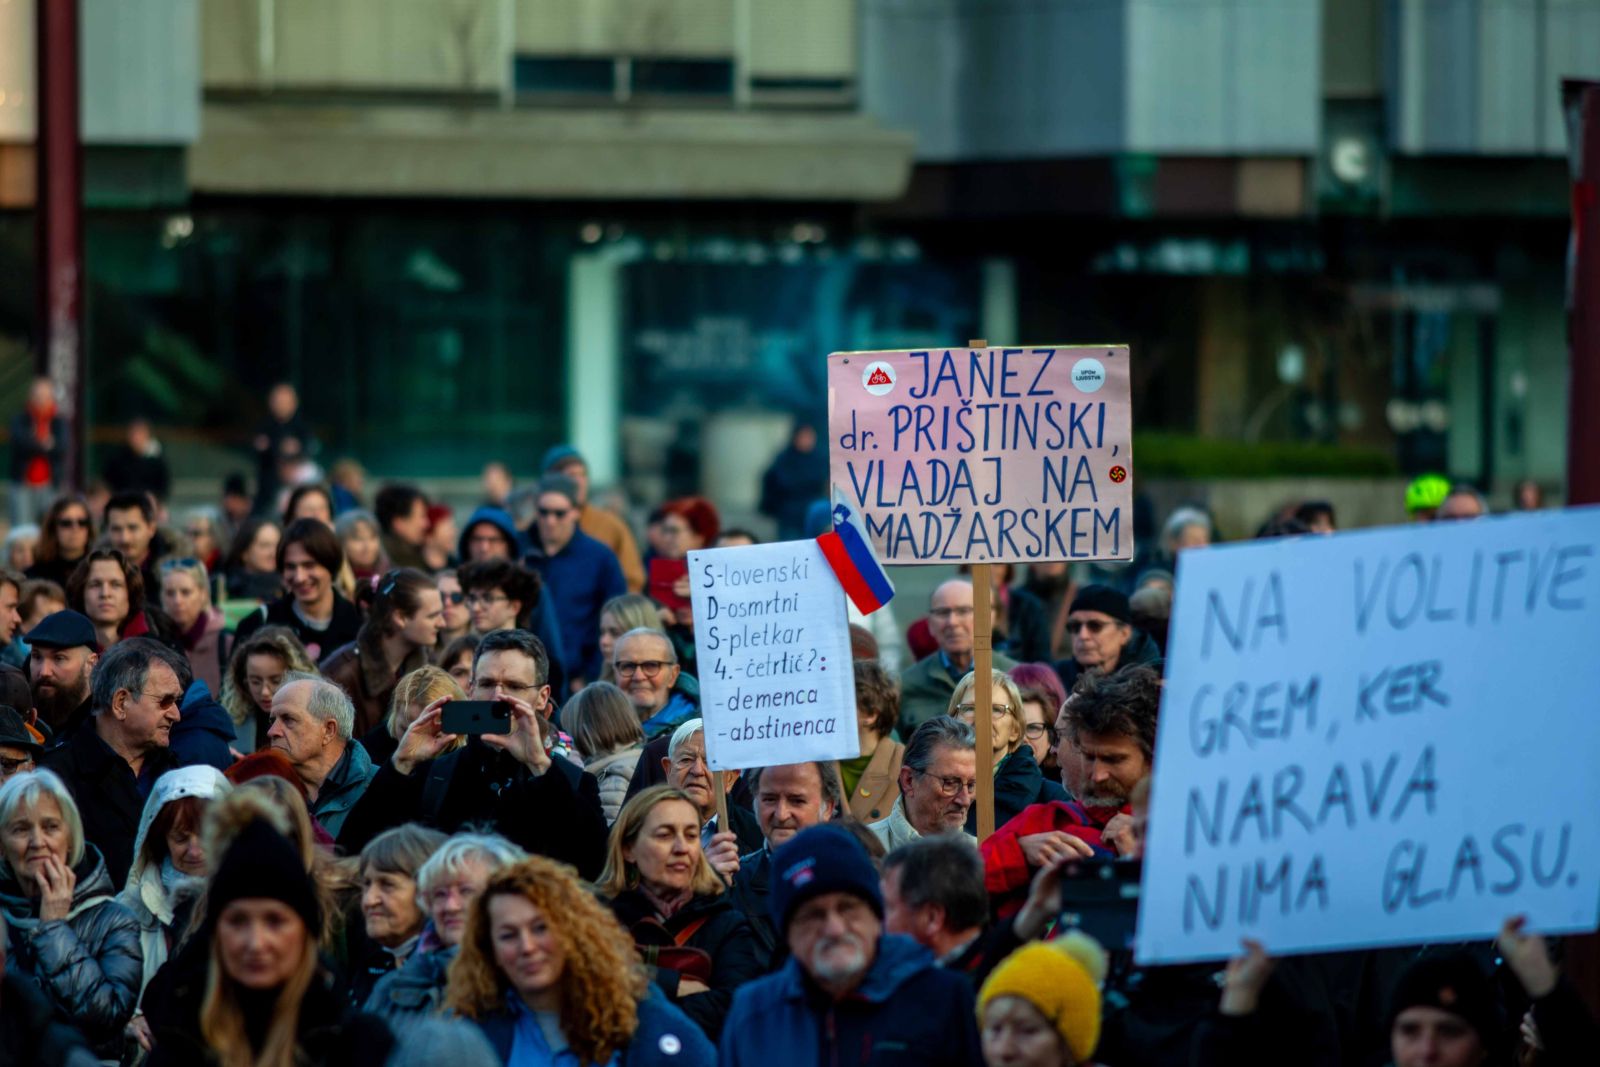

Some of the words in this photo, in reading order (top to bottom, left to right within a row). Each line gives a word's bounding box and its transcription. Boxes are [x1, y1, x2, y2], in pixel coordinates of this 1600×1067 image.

[909, 349, 1056, 399] JANEZ
[840, 409, 878, 451] dr.
[847, 456, 1002, 508] VLADAJ
[1042, 455, 1098, 503] NA
[865, 506, 1120, 560] MADŽARSKEM
[1201, 569, 1288, 659] NA
[1353, 543, 1594, 634] VOLITVE
[1189, 673, 1338, 759] GREM,
[1355, 659, 1450, 722] KER
[1184, 744, 1439, 857] NARAVA
[1183, 852, 1329, 934] NIMA
[1382, 821, 1579, 914] GLASU.
